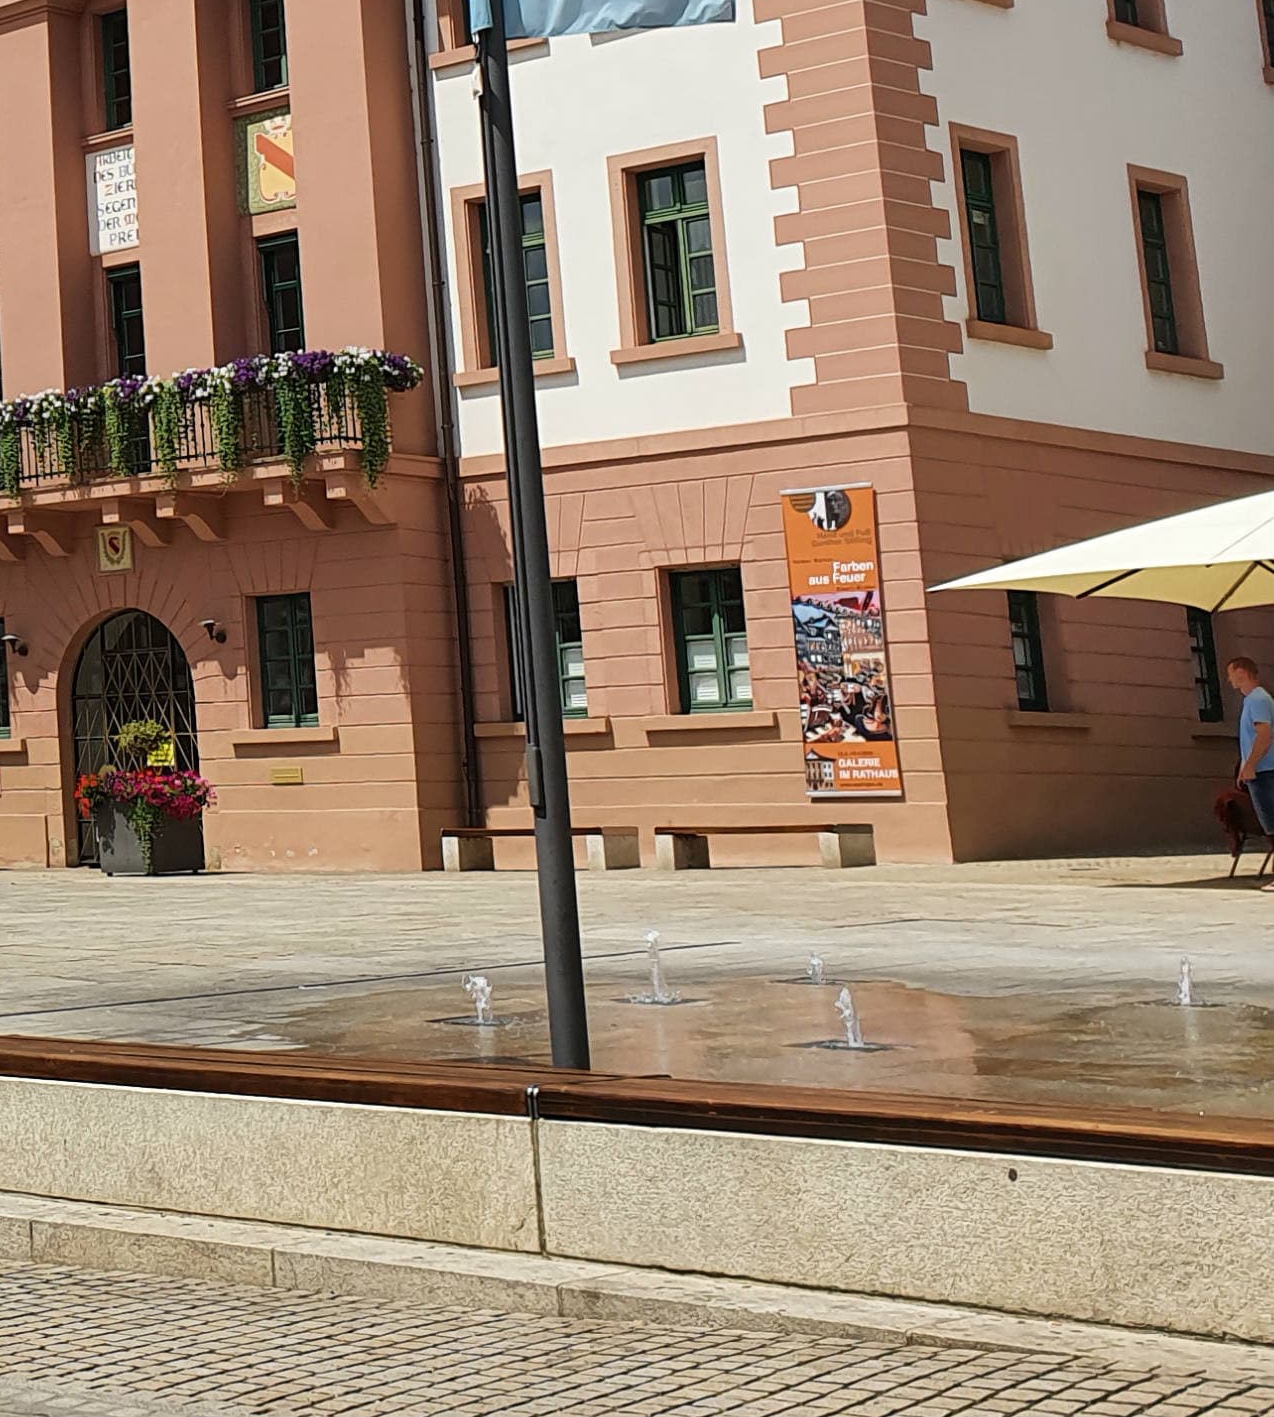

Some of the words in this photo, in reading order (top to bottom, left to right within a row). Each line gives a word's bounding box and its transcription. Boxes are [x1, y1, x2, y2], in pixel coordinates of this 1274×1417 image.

[104, 180, 136, 197] ZIER
[832, 561, 874, 573] Farben
[808, 575, 830, 586] aus
[832, 572, 866, 585] Feuer
[838, 757, 881, 768] GALERIE
[839, 769, 850, 780] IM
[852, 767, 899, 780] RATHAUS
